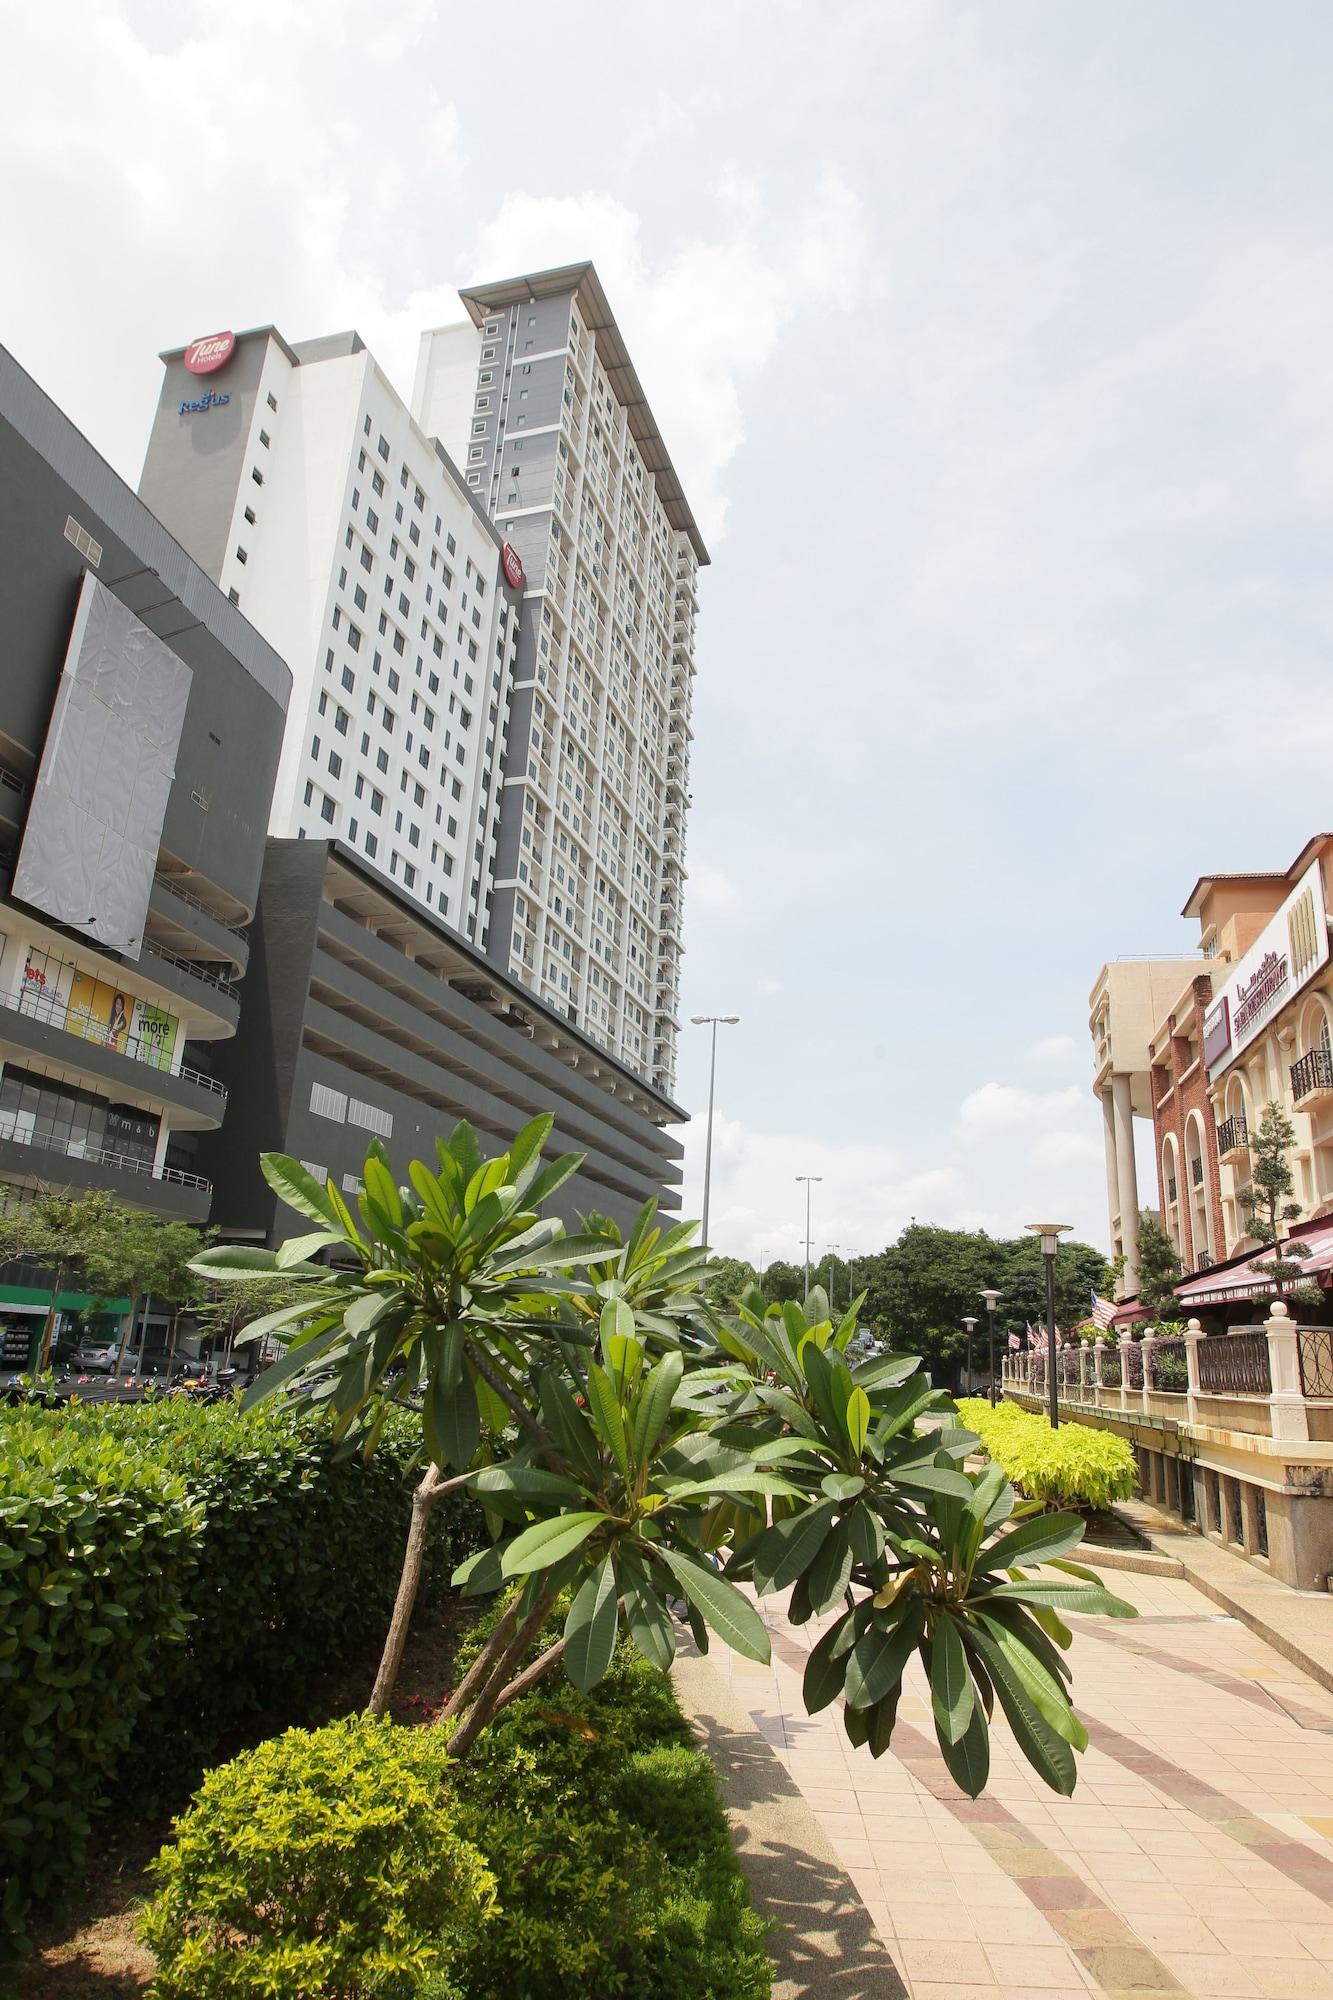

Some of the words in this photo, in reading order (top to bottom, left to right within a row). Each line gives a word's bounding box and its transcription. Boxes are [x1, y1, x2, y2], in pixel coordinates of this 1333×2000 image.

[190, 337, 230, 364] Tune
[178, 388, 230, 416] Regus
[506, 545, 522, 579] Tune
[138, 1019, 170, 1036] more
[121, 1119, 132, 1131] m
[148, 1125, 155, 1138] b
